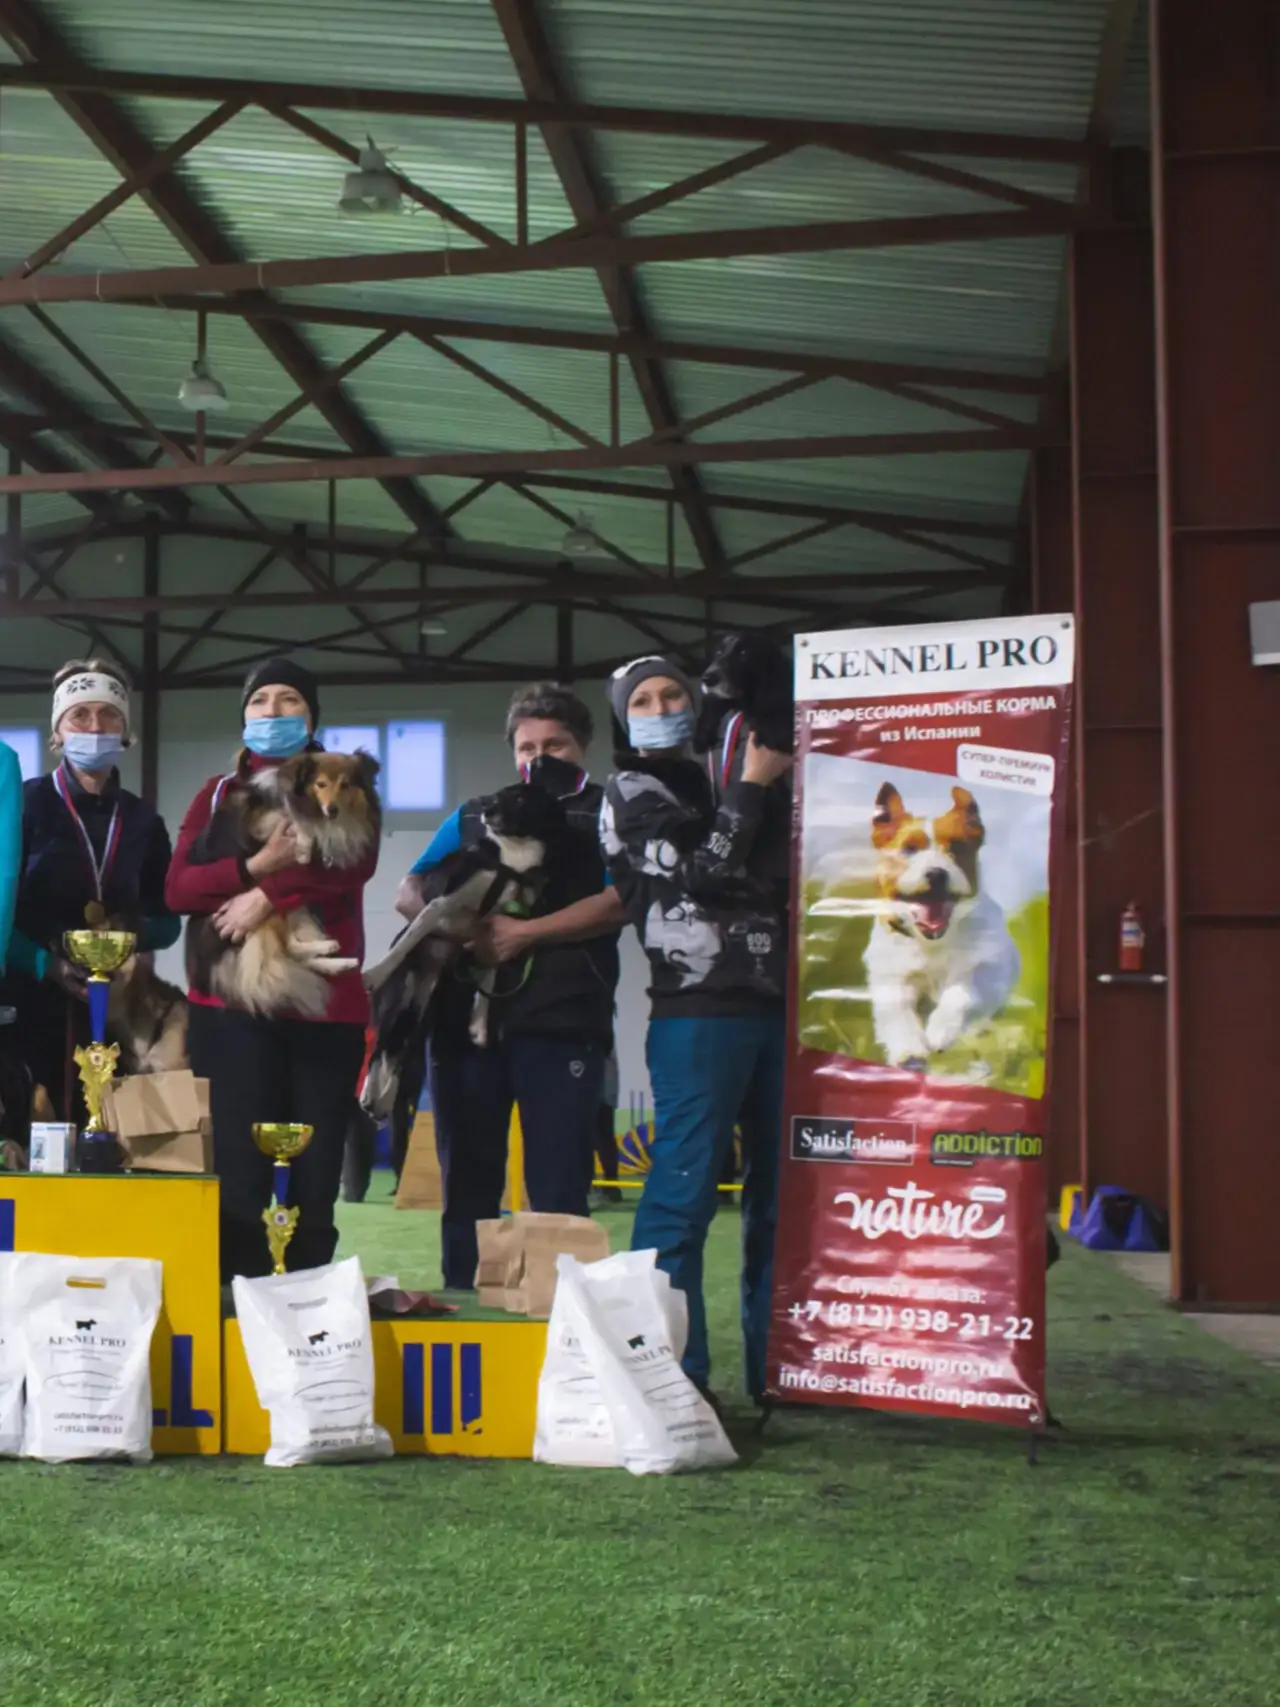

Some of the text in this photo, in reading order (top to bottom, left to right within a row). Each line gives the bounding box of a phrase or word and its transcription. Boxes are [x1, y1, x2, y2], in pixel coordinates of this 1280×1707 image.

[809, 634, 1058, 681] KENNEL PRO
[805, 694, 1057, 724] ПРОФЕССИОНАЛЬНЫЕ КОРМА
[879, 724, 982, 743] из Испании
[788, 1300, 1034, 1340] +7 (812) 938-21-22
[778, 1367, 1033, 1410] info@satisfactionpro.ru
